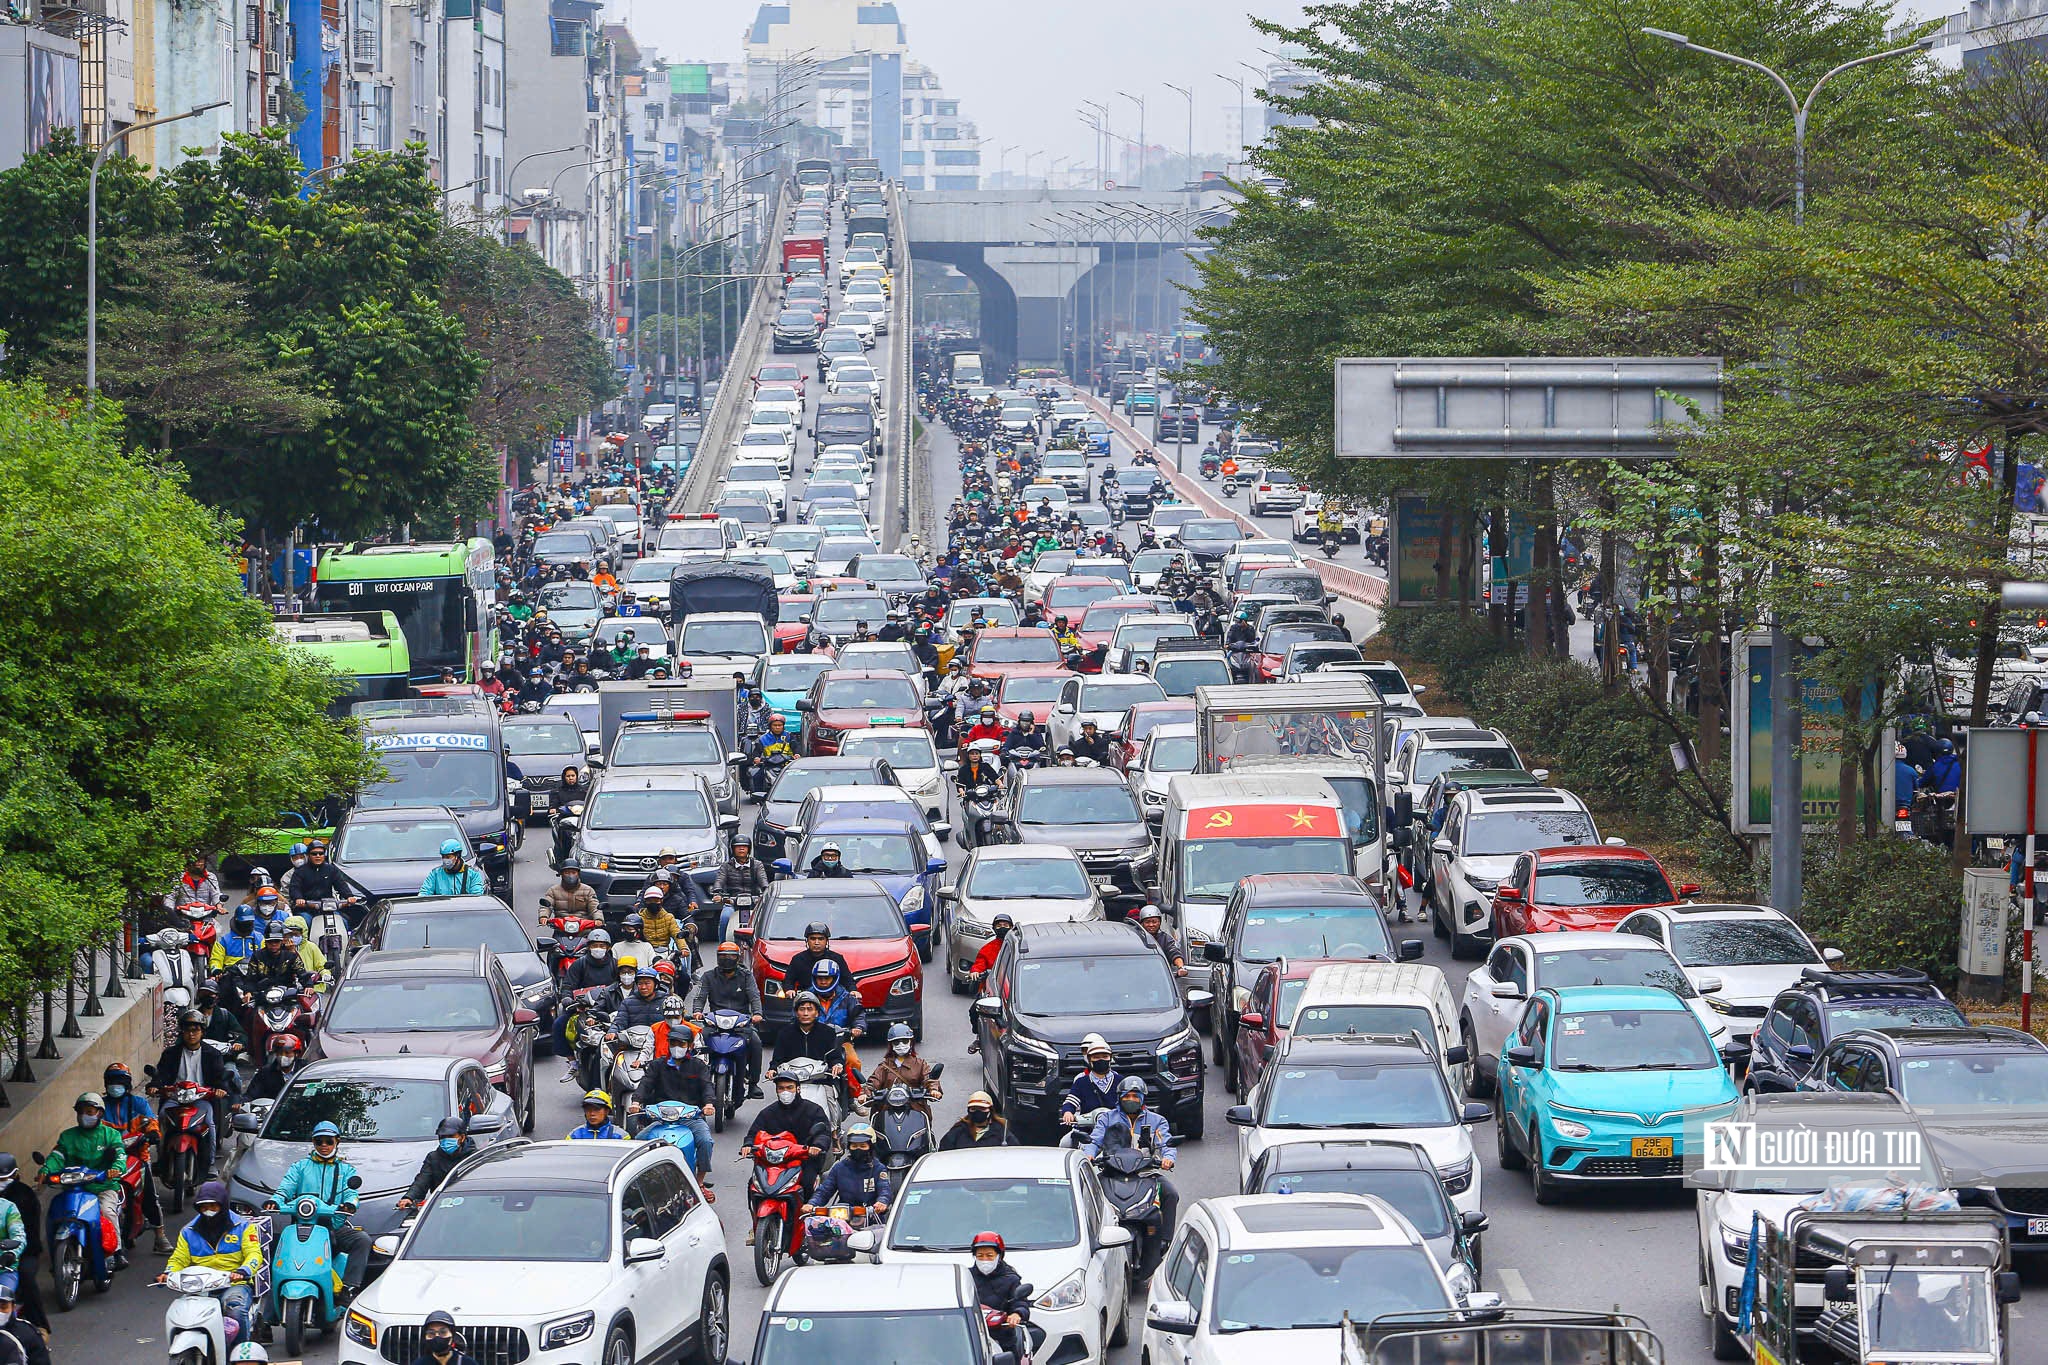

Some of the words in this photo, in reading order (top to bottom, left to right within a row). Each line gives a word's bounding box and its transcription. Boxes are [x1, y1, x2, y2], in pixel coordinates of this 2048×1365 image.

[349, 583, 363, 596] E01
[390, 583, 415, 593] OCEAN
[436, 735, 484, 747] CÔNG
[1801, 802, 1841, 815] CITY
[322, 1086, 341, 1094] TAXI
[1643, 1138, 1661, 1147] 29E
[1636, 1147, 1668, 1157] 064.30
